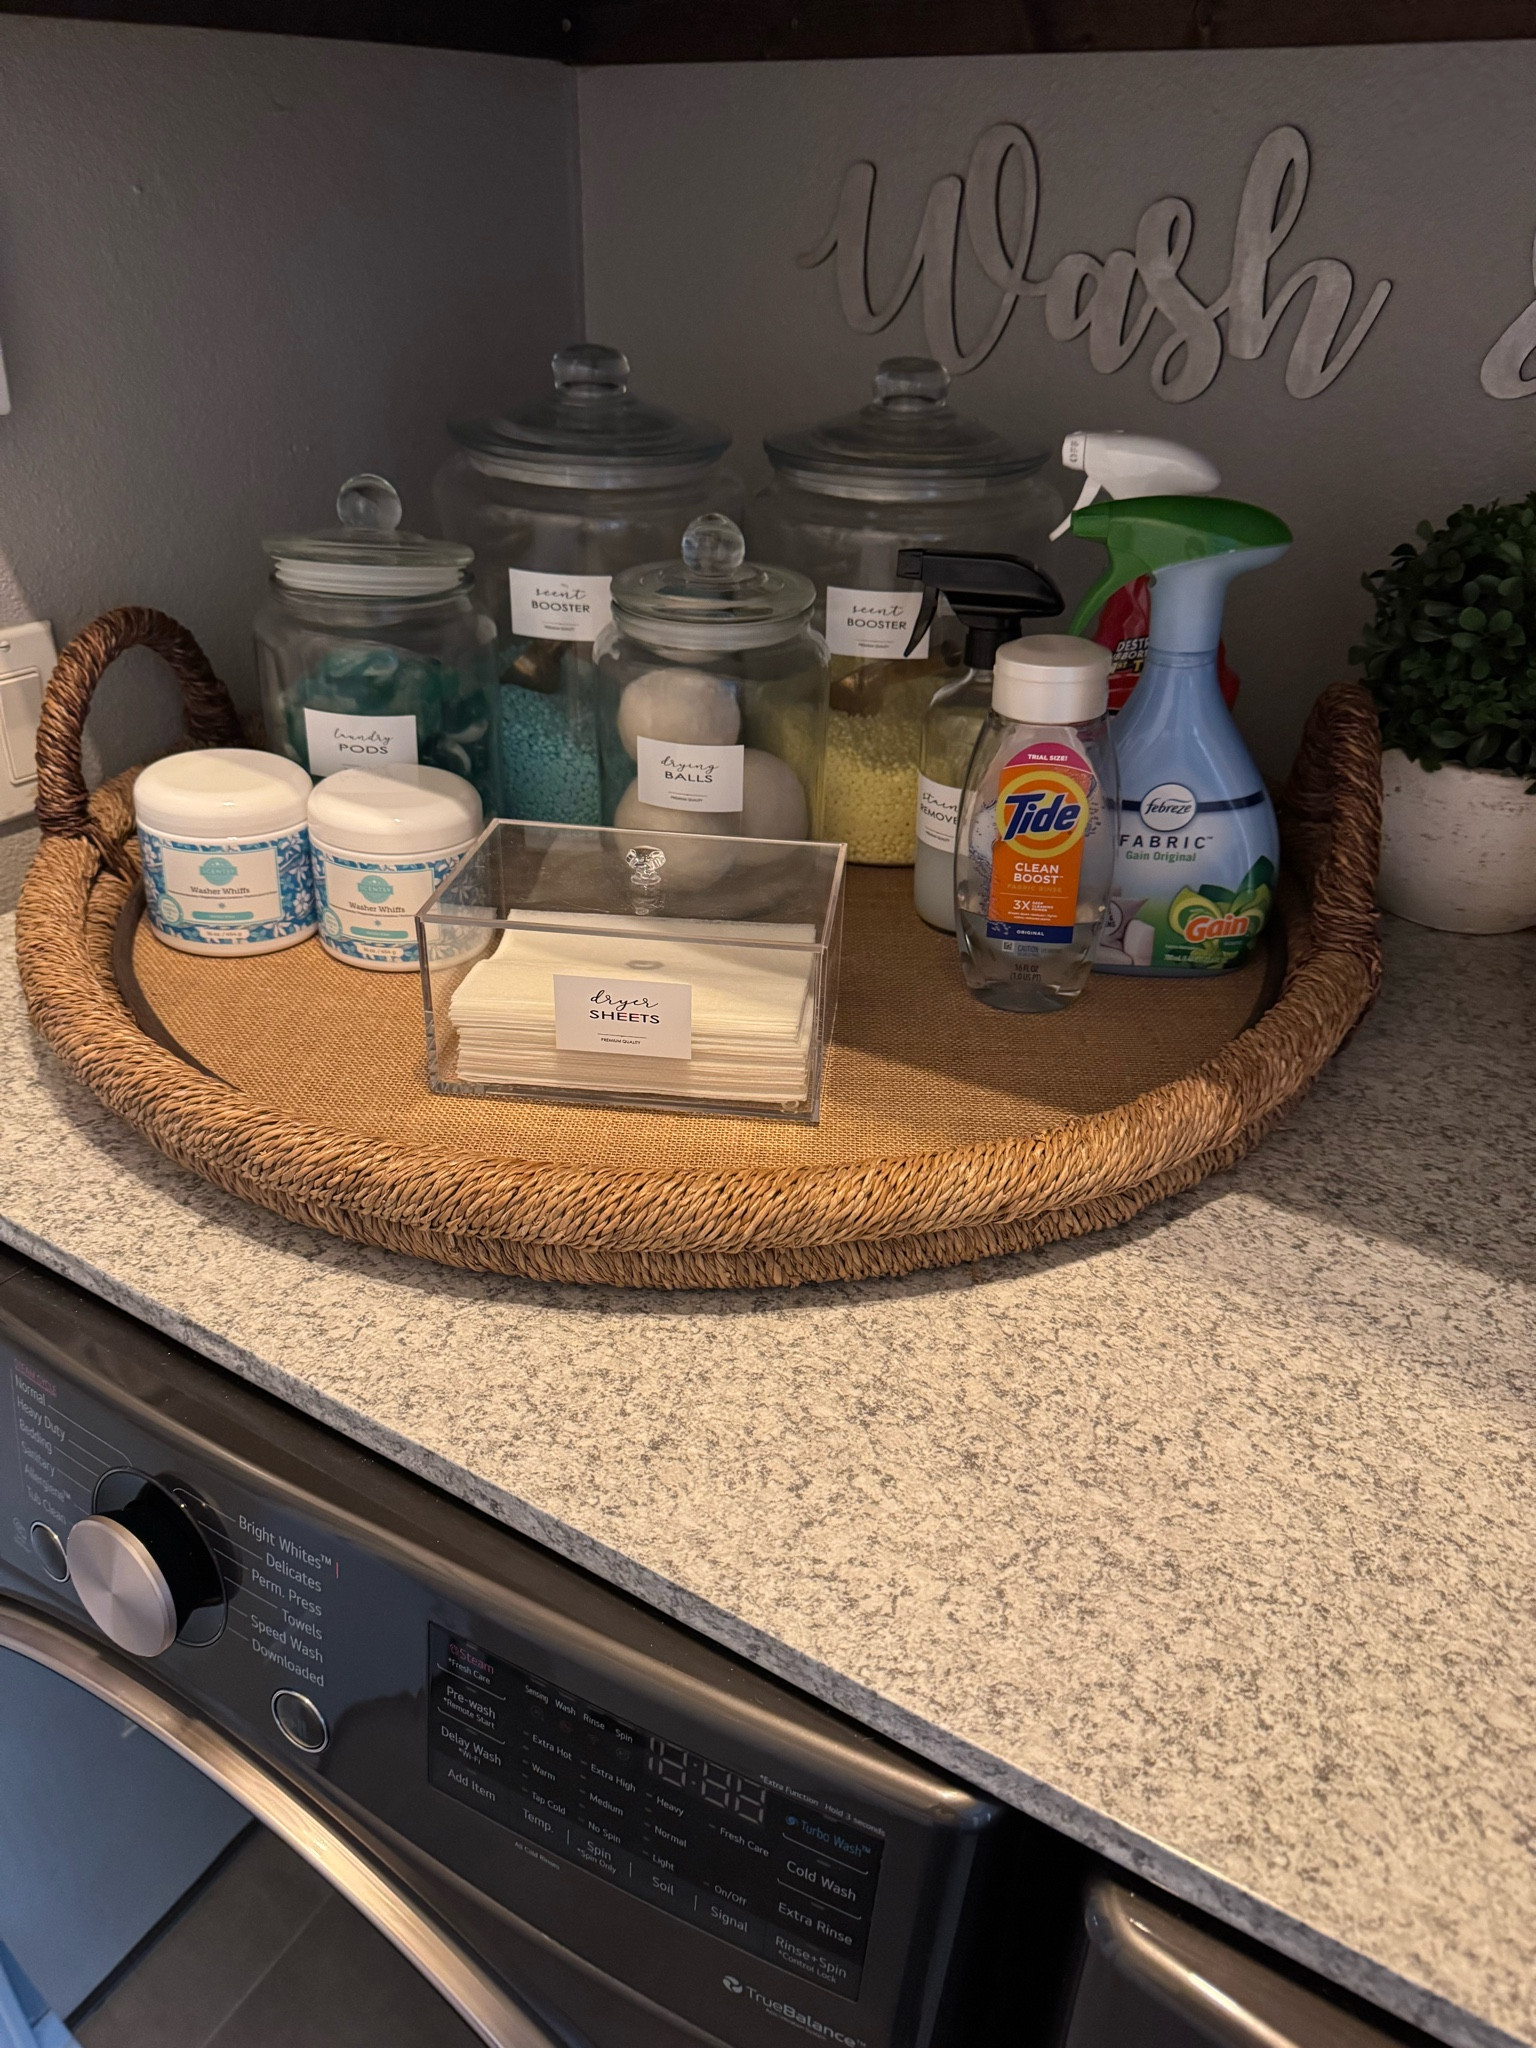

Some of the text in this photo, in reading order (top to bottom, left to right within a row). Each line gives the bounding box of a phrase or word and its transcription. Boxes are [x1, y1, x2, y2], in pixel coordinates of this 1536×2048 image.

[800, 122, 1393, 403] Wash
[535, 587, 588, 600] scent
[531, 600, 590, 613] BOOSTER
[852, 605, 904, 617] scent
[847, 618, 907, 630] BOOSTER
[334, 728, 394, 745] laundry
[339, 743, 389, 755] PODS
[660, 755, 719, 775] drying
[664, 771, 713, 783] BALLS
[920, 803, 958, 825] REMOVE
[1003, 793, 1081, 840] Tide
[1144, 797, 1192, 815] febreze
[1015, 862, 1059, 874] CLEAN
[1126, 850, 1196, 863] Gain Original
[190, 886, 220, 895] Washer
[349, 901, 377, 912] Washer
[1013, 899, 1031, 911] 3X
[1184, 913, 1249, 943] Gain
[590, 989, 659, 1012] dryer
[589, 1009, 660, 1025] SHEETS
[15, 1374, 46, 1406] Normal
[17, 1395, 66, 1442] Heavy Duty
[239, 1515, 276, 1547] Bright
[266, 1552, 322, 1592] Delicates
[252, 1568, 322, 1617] Perm. Press
[282, 1608, 323, 1641] Towels
[251, 1614, 323, 1664] Speed Wash
[252, 1638, 324, 1687] Downloaded
[459, 1648, 494, 1675] Steam
[473, 1671, 491, 1685] Care
[446, 1685, 496, 1720] Pre-wash
[525, 1684, 633, 1744] Sensing Wash Rinse Spin
[476, 1713, 495, 1730] Start
[441, 1725, 502, 1766] Delay Wash
[532, 1734, 573, 1761] Extra Hot
[532, 1762, 556, 1782] Warm
[591, 1763, 636, 1793] Extra High
[448, 1768, 496, 1802] Add Item
[532, 1791, 566, 1815] Tap Cold
[590, 1792, 624, 1816] Medium
[656, 1795, 685, 1817] Heavy
[785, 1786, 819, 1806] Function
[853, 1817, 885, 1837] seconds
[522, 1808, 555, 1833] Temp.
[801, 1820, 830, 1843] Turbo
[588, 1821, 621, 1844] No Spin
[654, 1825, 687, 1848] Normal
[720, 1827, 770, 1857] Fresh Care
[587, 1840, 612, 1861] Spin
[599, 1858, 617, 1875] Only
[652, 1853, 674, 1872] Light
[652, 1876, 674, 1896] Soil
[786, 1860, 857, 1902] Cold Wash
[714, 1884, 748, 1907] On/Off
[710, 1906, 748, 1933] Signal
[778, 1902, 853, 1946] Extra Rinse
[775, 1935, 847, 1979] Rinse+Spin
[817, 1967, 837, 1984] Lock
